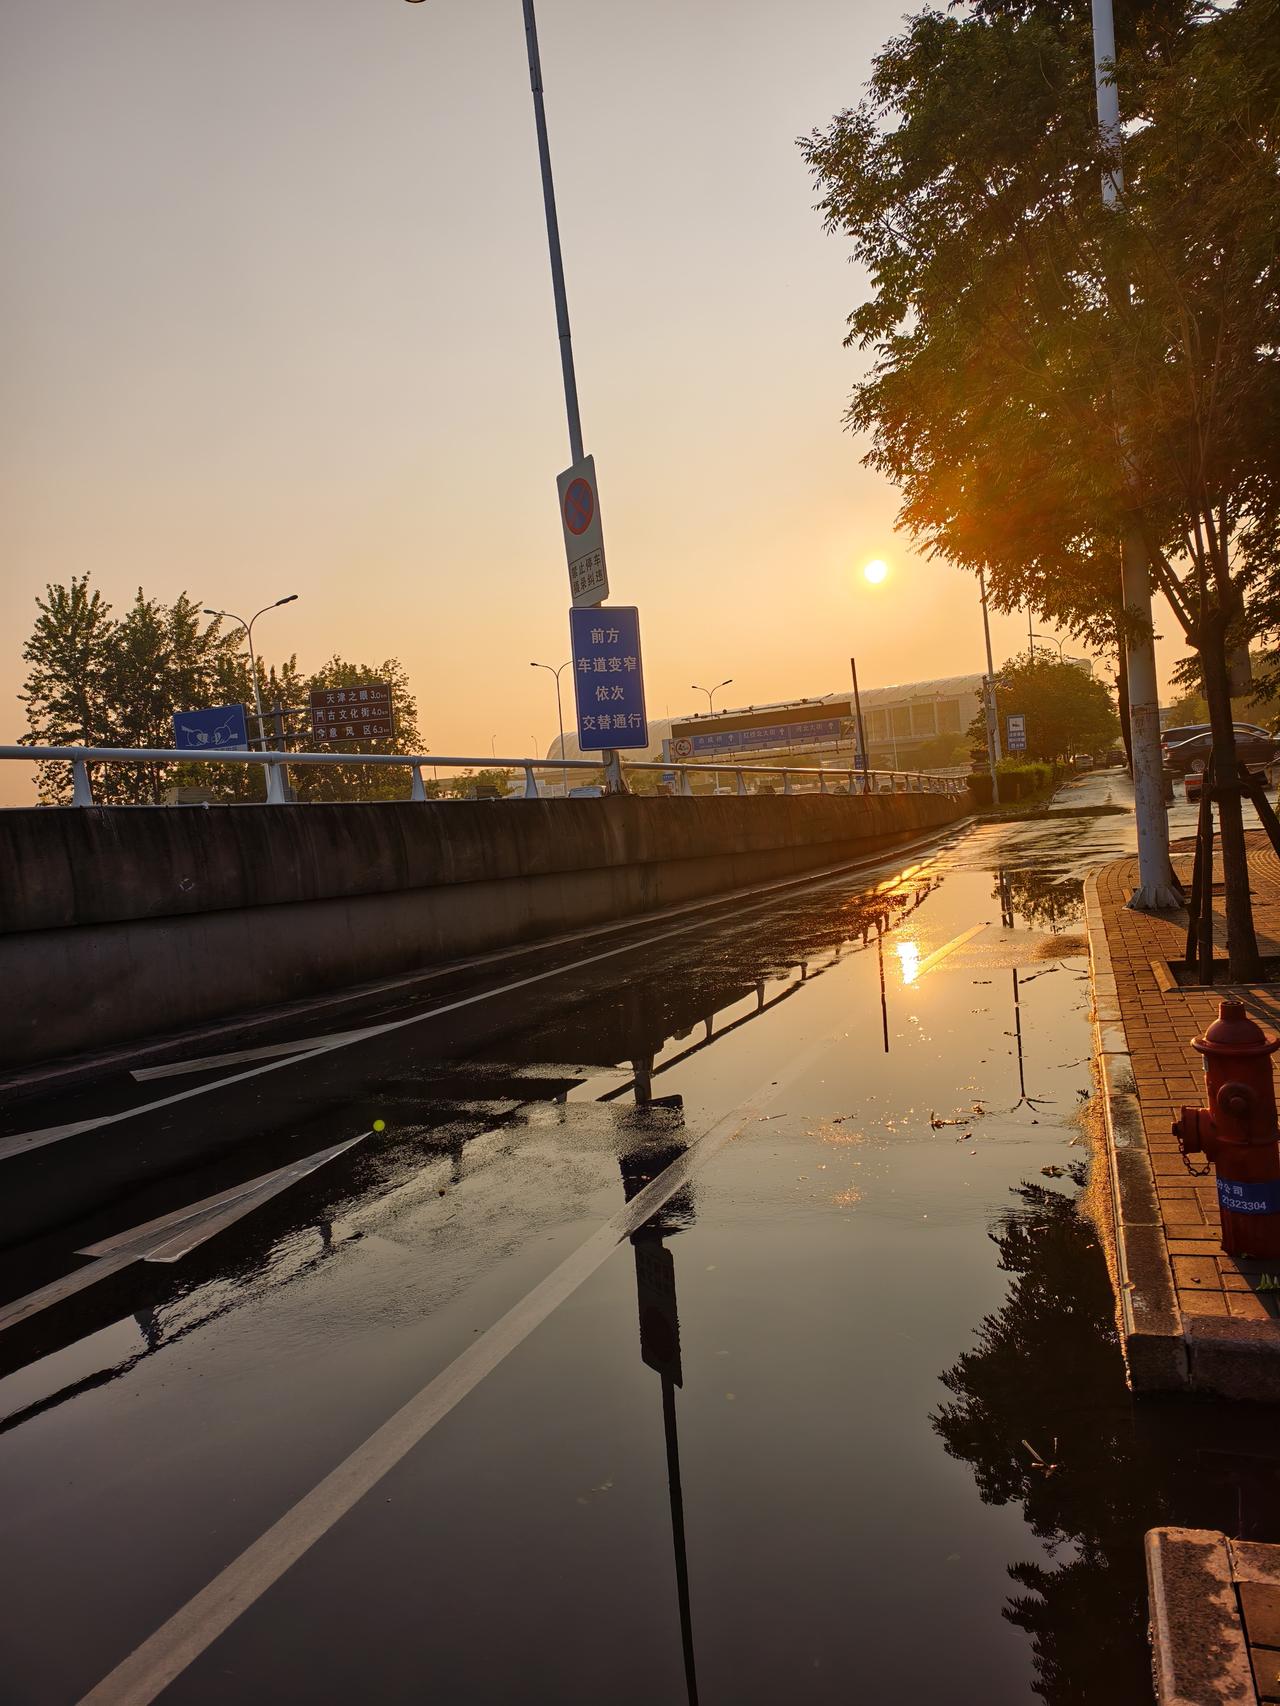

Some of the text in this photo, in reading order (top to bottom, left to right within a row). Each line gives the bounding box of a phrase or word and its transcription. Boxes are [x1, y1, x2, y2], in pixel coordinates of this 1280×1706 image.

[590, 627, 620, 644] 前方
[577, 656, 637, 673] 车道变窄
[326, 690, 369, 704] 天津之眼
[595, 685, 625, 701] 依次
[328, 707, 370, 721] 古文化街
[582, 713, 642, 731] 交替通行
